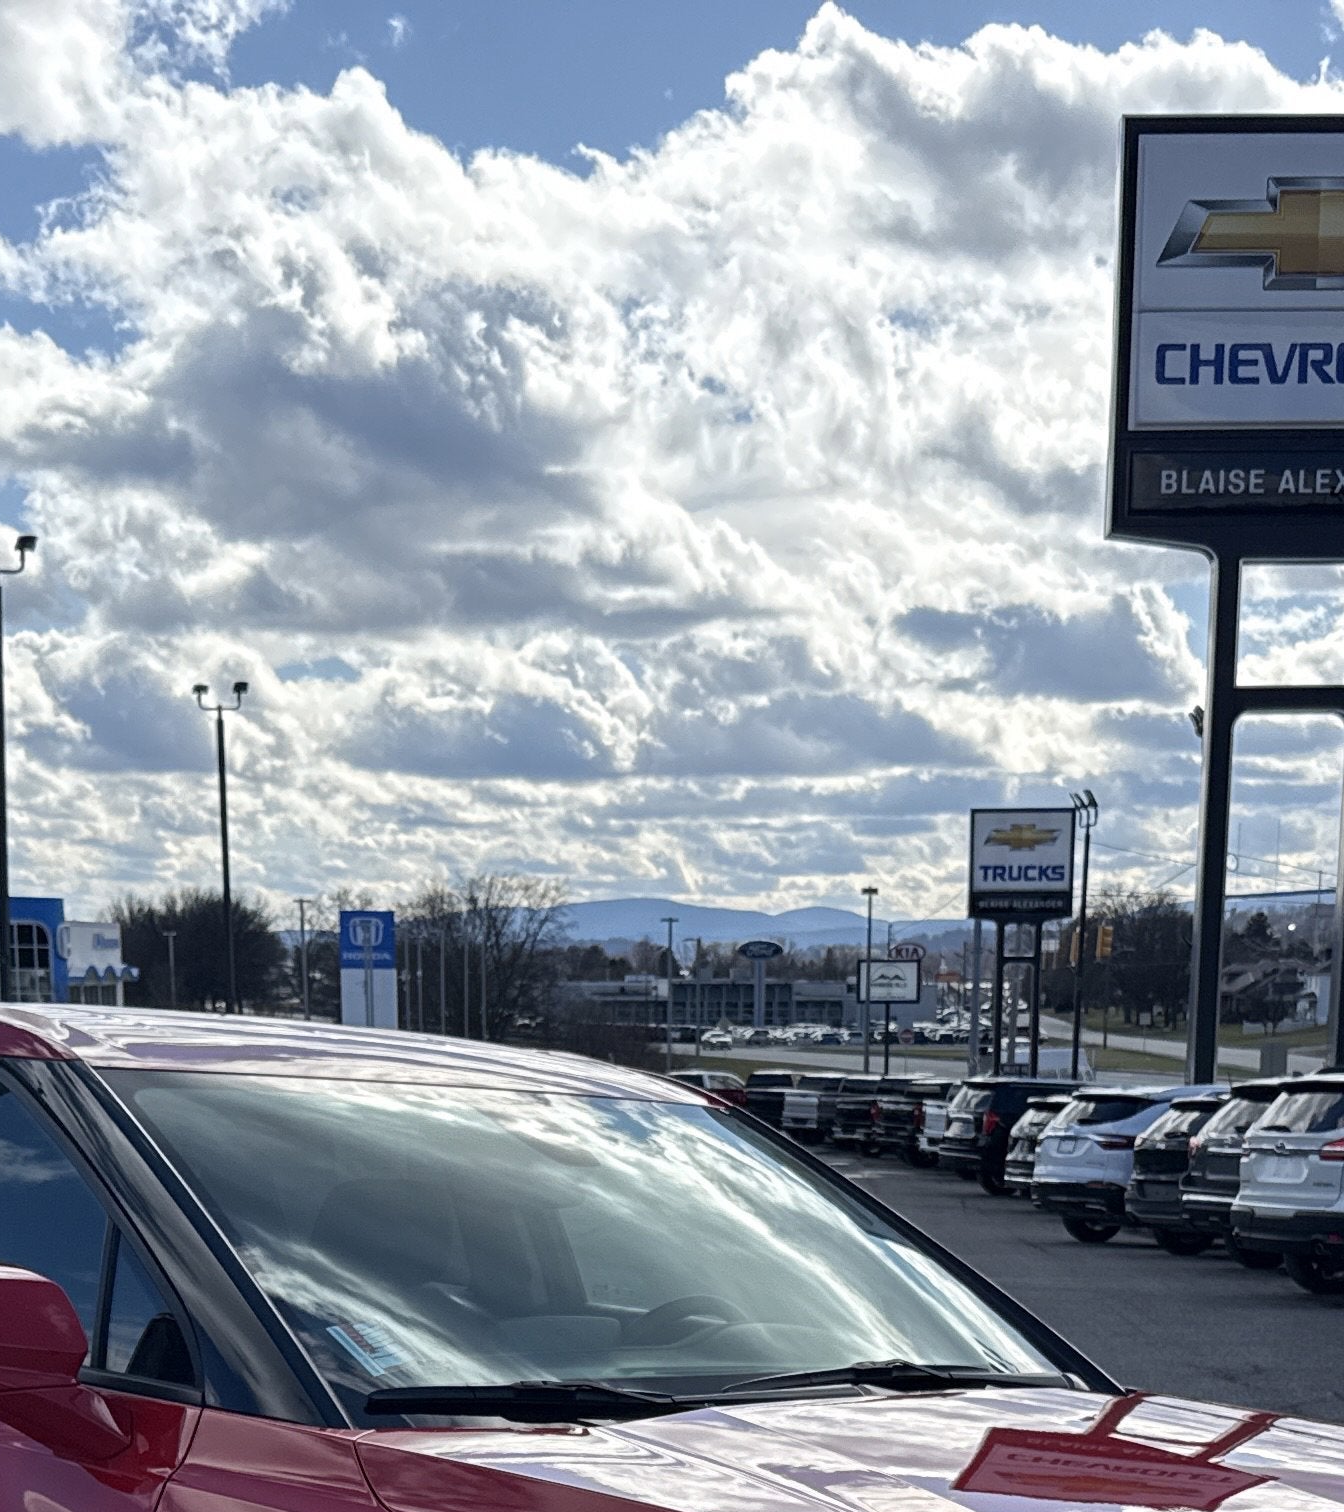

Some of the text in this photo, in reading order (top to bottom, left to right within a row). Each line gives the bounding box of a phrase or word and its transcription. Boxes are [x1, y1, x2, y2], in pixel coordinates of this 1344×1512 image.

[1160, 468, 1266, 496] BLAISE
[979, 865, 1066, 882] TRUCKS
[895, 946, 921, 958] KIA
